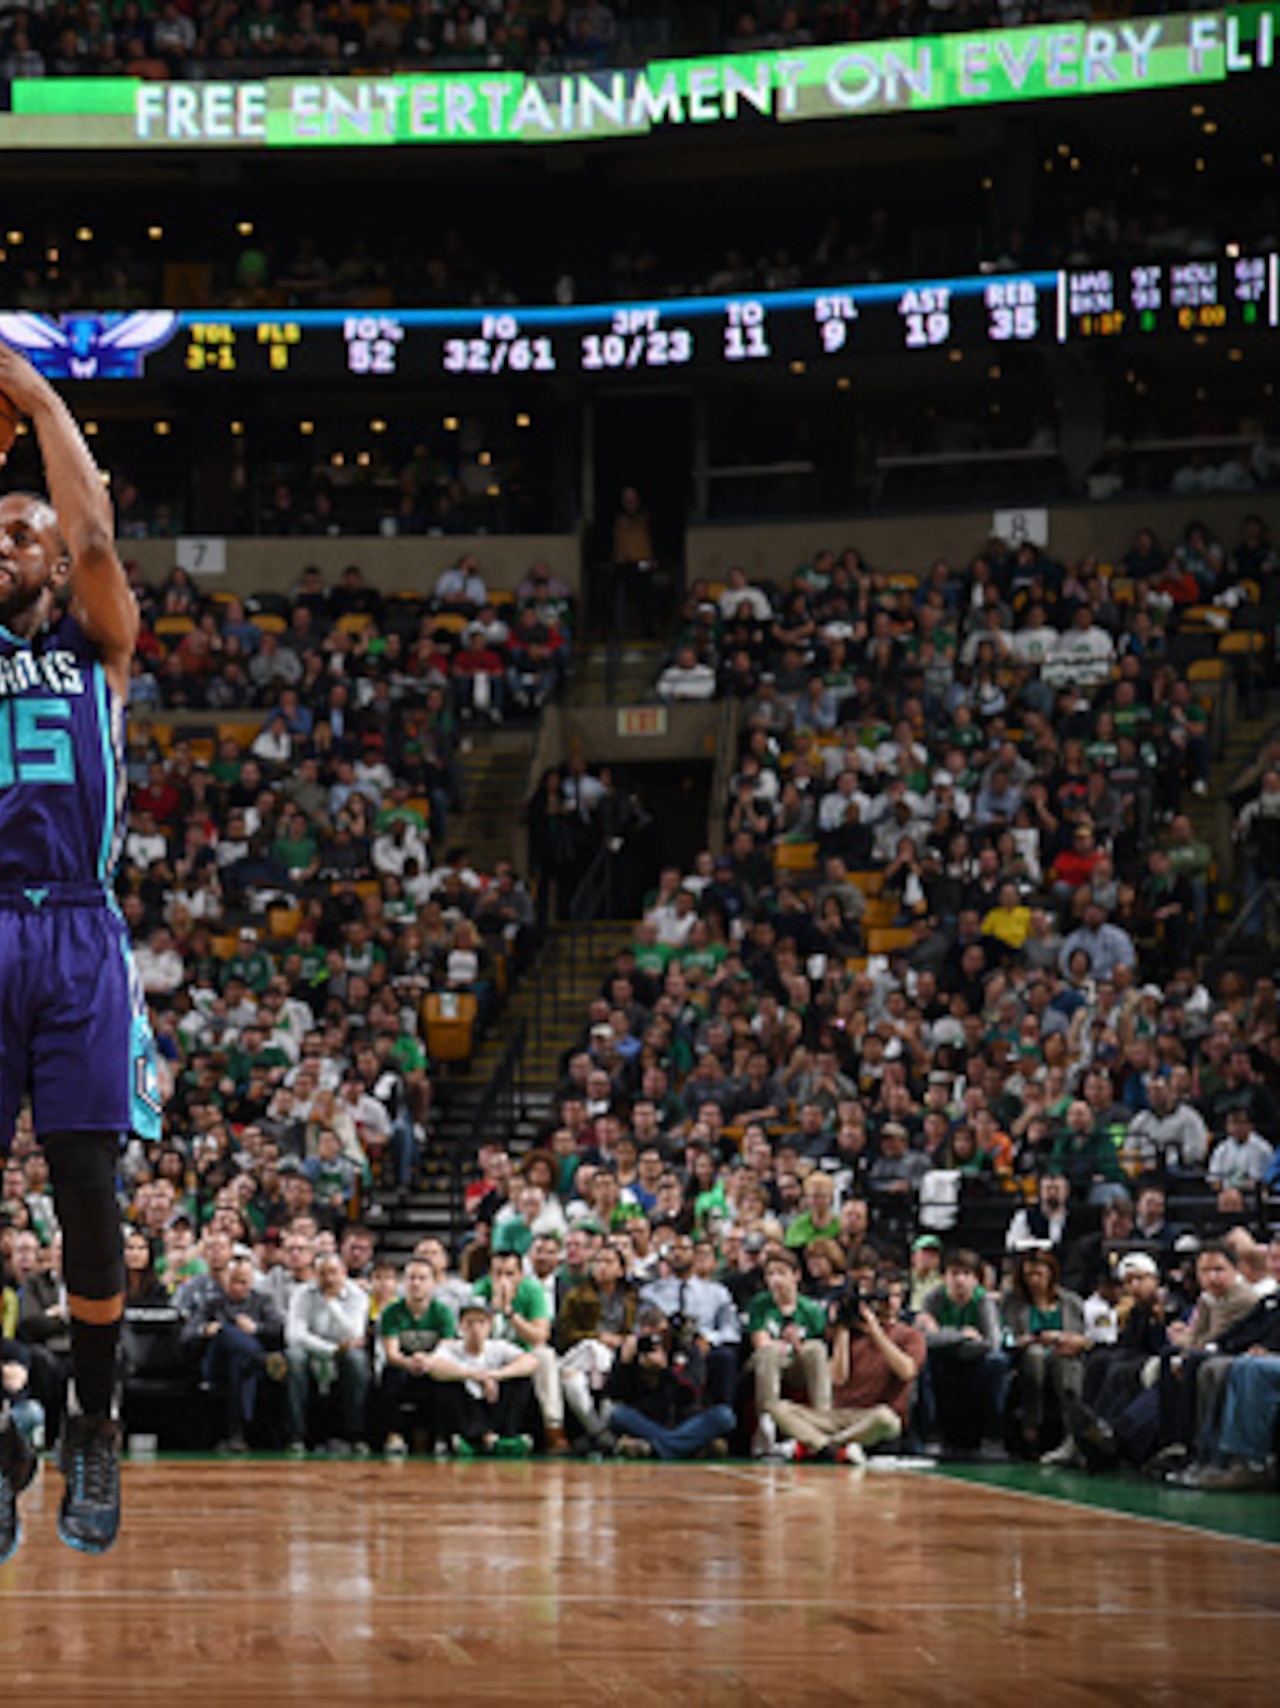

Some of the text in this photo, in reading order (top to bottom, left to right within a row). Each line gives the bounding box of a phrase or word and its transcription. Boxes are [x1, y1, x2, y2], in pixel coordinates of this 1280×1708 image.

[135, 12, 1274, 139] FREE ENTERTAINMENT ON EVERY FLI
[725, 301, 764, 327] TO
[814, 296, 858, 322] STL
[898, 287, 950, 315] AST
[821, 318, 847, 353] 9
[904, 312, 950, 348] 19
[987, 304, 1038, 340] 35
[347, 340, 396, 373] 52
[442, 338, 556, 374] 32/61
[581, 329, 691, 369] 10/23
[724, 325, 769, 361] 11
[192, 544, 208, 568] 7
